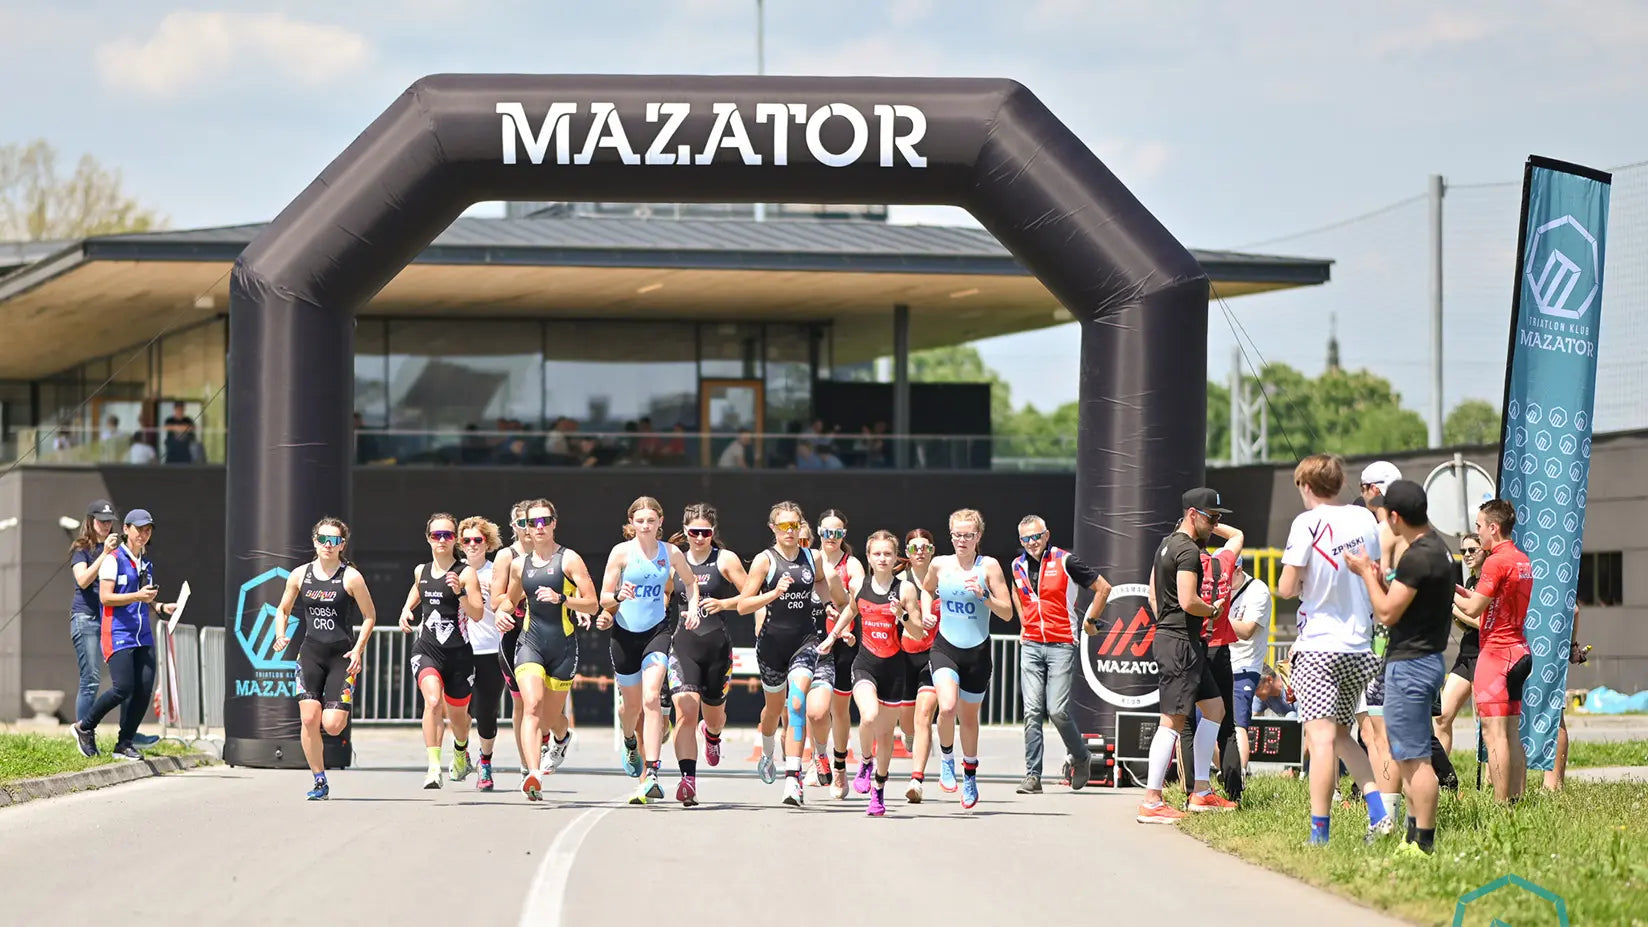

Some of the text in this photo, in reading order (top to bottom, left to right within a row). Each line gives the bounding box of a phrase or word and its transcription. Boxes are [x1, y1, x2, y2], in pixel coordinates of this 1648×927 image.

[495, 102, 928, 168] MAZATOR
[1529, 316, 1590, 336] TRIATLON KLUB
[1520, 329, 1594, 357] MAZATOR
[634, 584, 662, 598] CRO
[309, 606, 338, 617] DOBŠA
[787, 601, 804, 609] CRO
[946, 600, 976, 615] CRO
[313, 617, 335, 630] CRO
[871, 631, 888, 640] CRO
[1097, 660, 1160, 674] MAZATO
[236, 680, 297, 697] MAZAT
